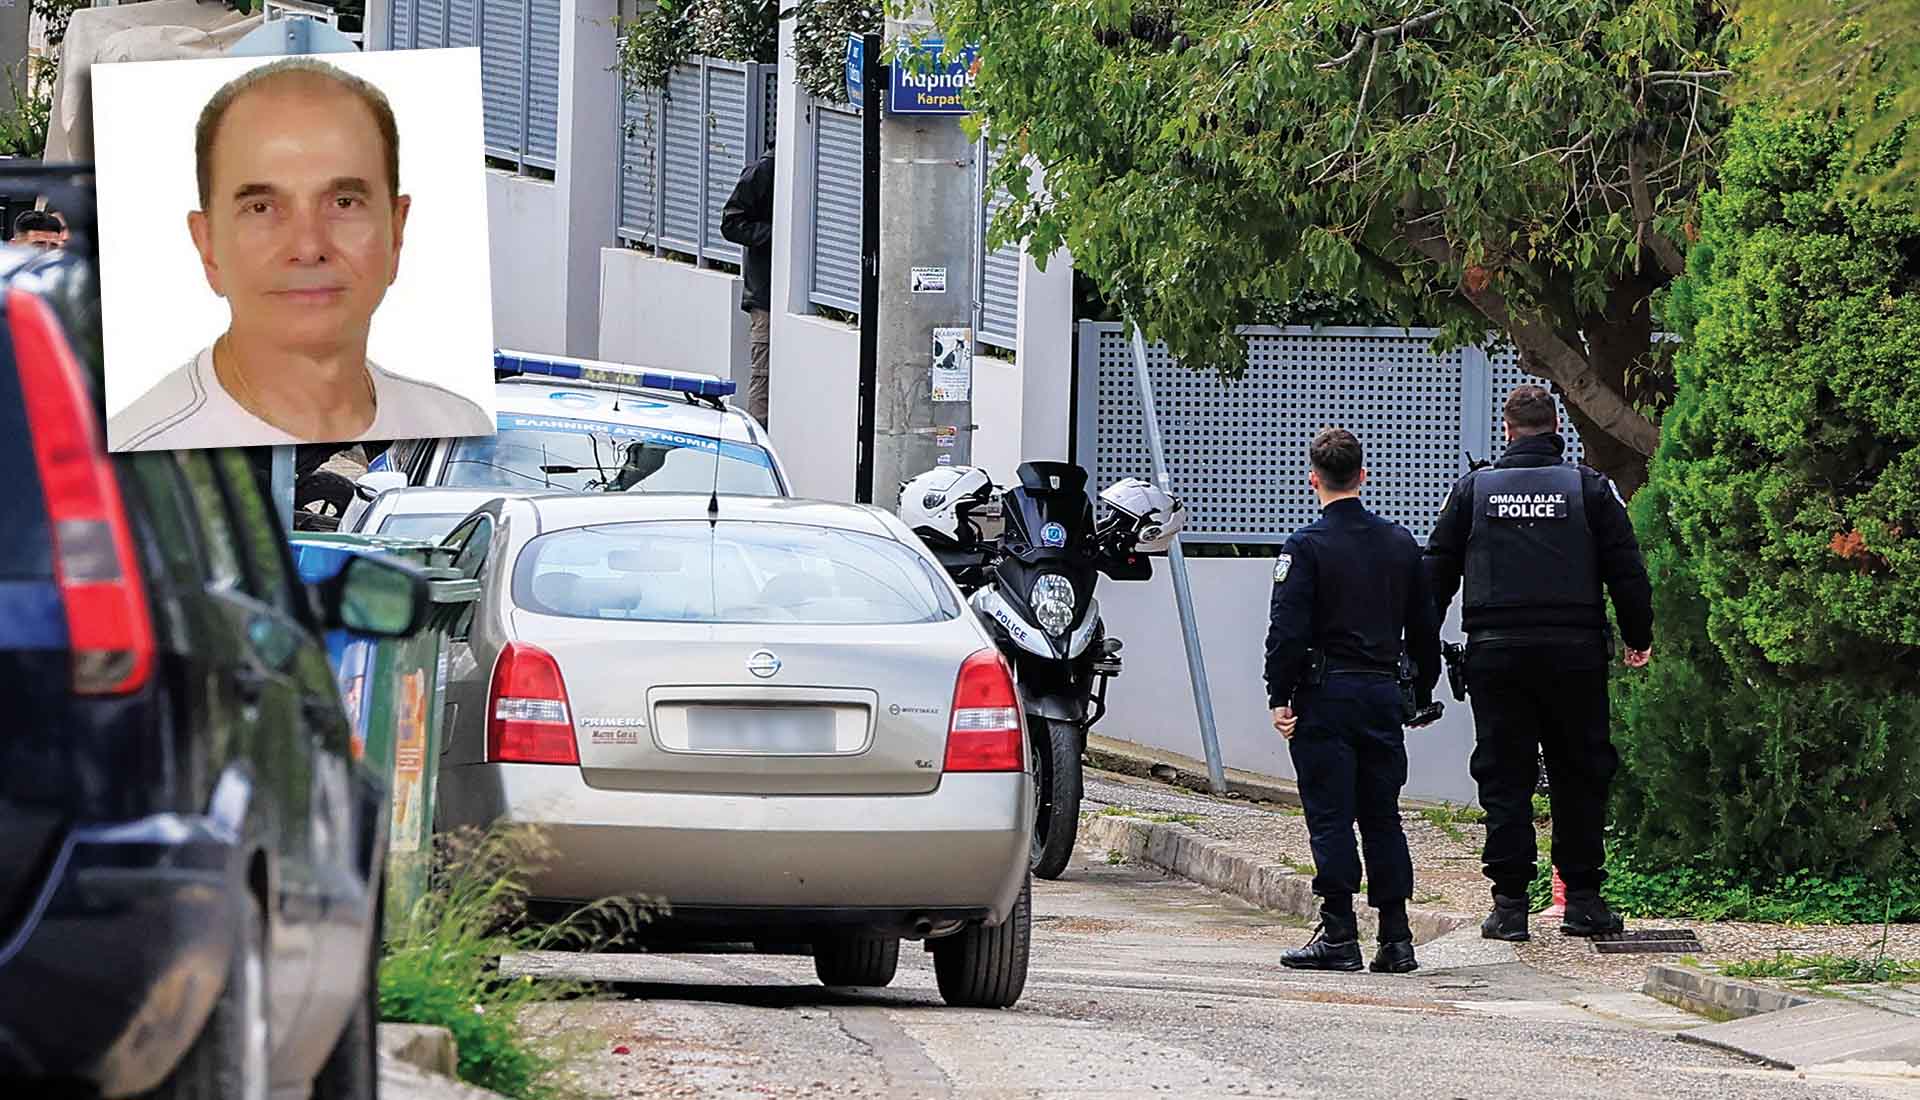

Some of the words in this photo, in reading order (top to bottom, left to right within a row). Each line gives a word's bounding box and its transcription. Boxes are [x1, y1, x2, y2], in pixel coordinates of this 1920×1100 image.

[901, 69, 977, 92] Καρπάθ
[917, 93, 961, 107] Karpat
[514, 418, 609, 434] ΕΛΛΗΝΙΚΗ
[615, 426, 719, 451] ΑΣΤΥΝΟΜΙΑ
[1488, 494, 1532, 504] ΟΜΑΔΑ
[1498, 504, 1555, 517] POLICE
[995, 609, 1029, 642] POLICE
[580, 717, 647, 728] PRIMERA
